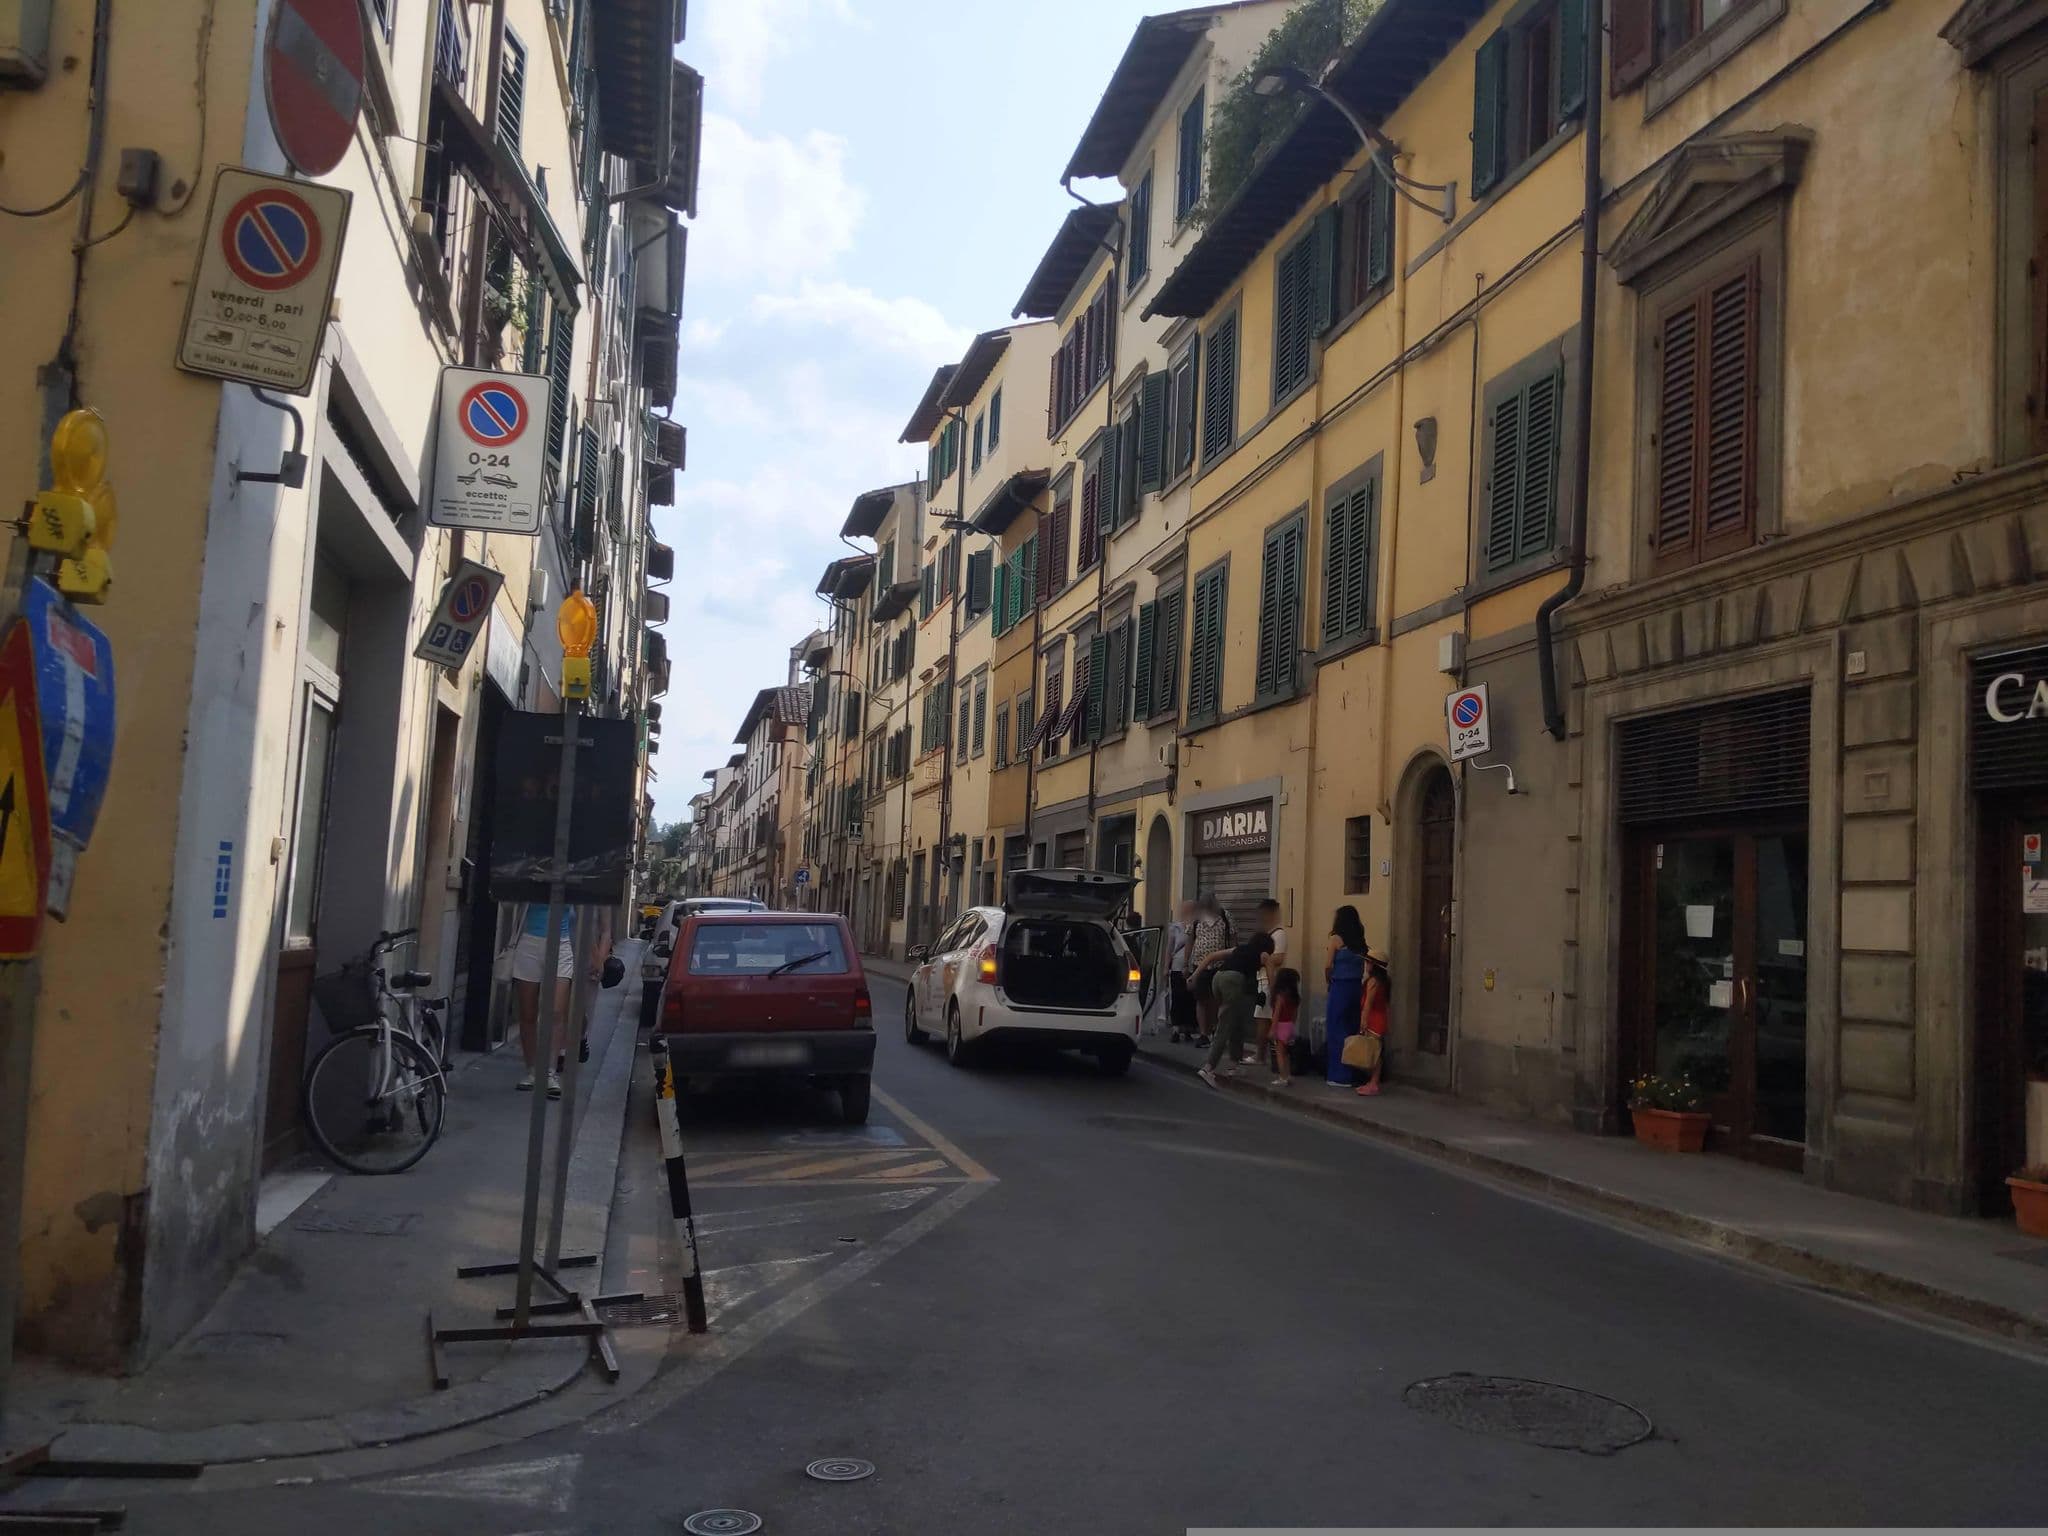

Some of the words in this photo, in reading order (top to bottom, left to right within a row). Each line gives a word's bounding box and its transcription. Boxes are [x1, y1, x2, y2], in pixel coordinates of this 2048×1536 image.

[274, 302, 304, 317] pari
[469, 452, 511, 468] 0-24
[466, 491, 507, 501] eccetto:
[433, 626, 447, 642] P
[1458, 728, 1480, 741] 0-24
[1202, 810, 1268, 841] DJÀRIA
